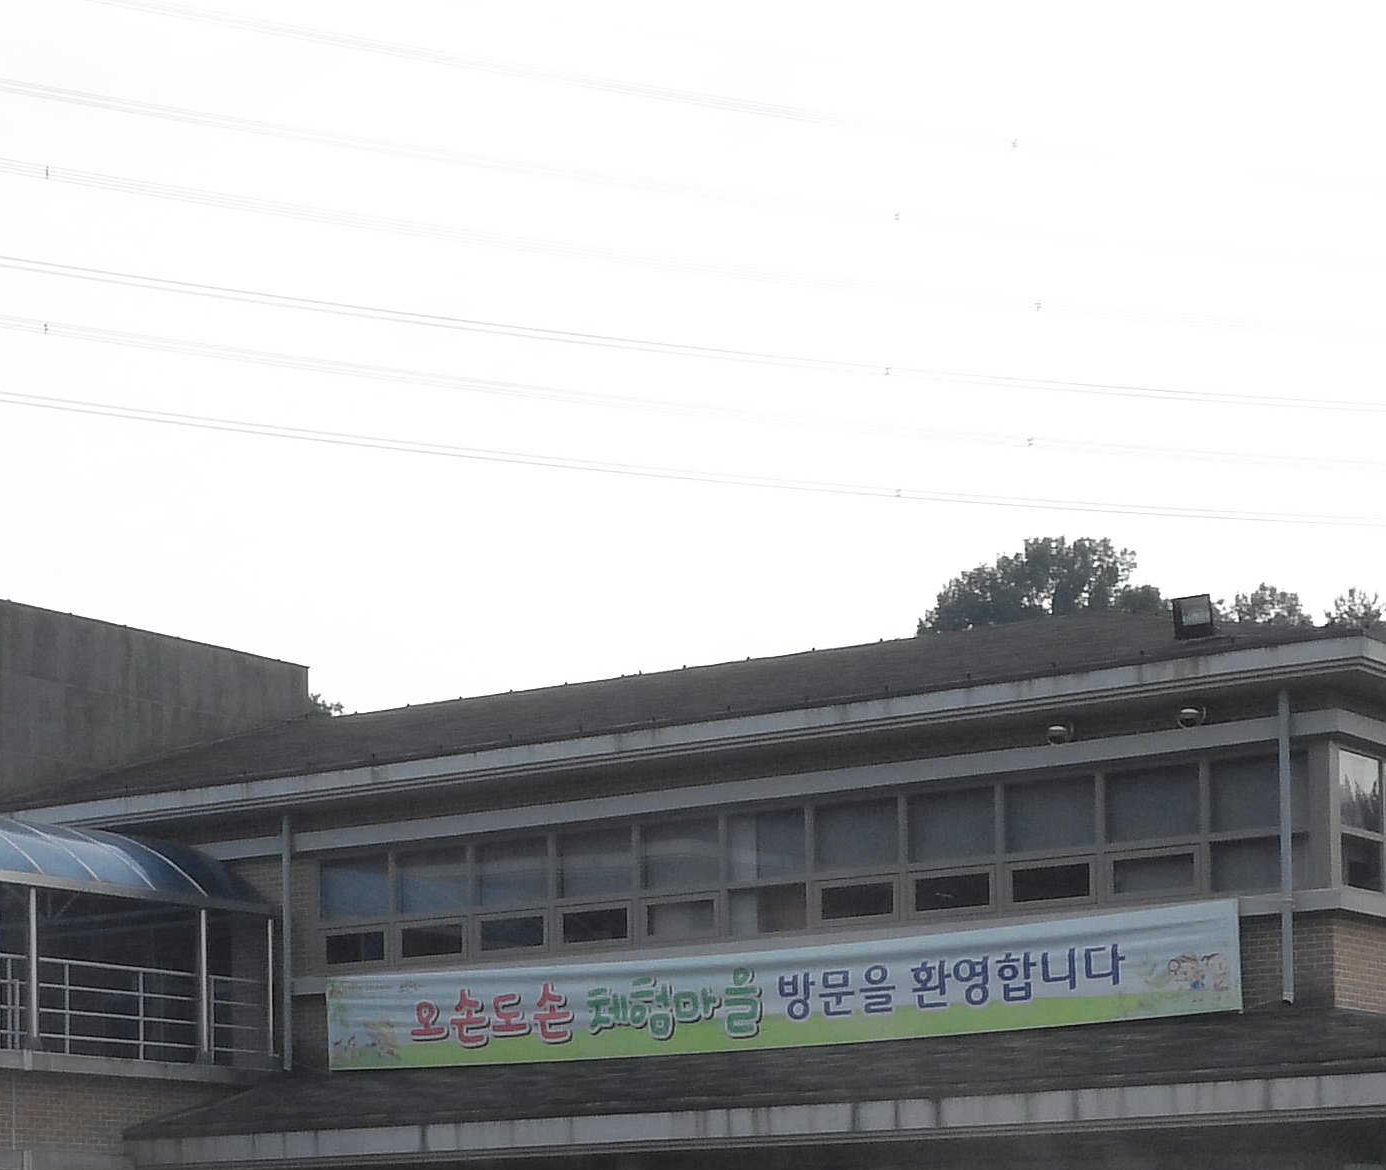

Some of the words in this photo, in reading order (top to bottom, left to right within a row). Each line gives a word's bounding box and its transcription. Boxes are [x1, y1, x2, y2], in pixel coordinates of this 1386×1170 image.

[411, 982, 573, 1047] 오손도손
[587, 967, 762, 1040] 체험마을
[778, 965, 896, 1020] 방문을
[911, 944, 1126, 1009] 환영합니다
